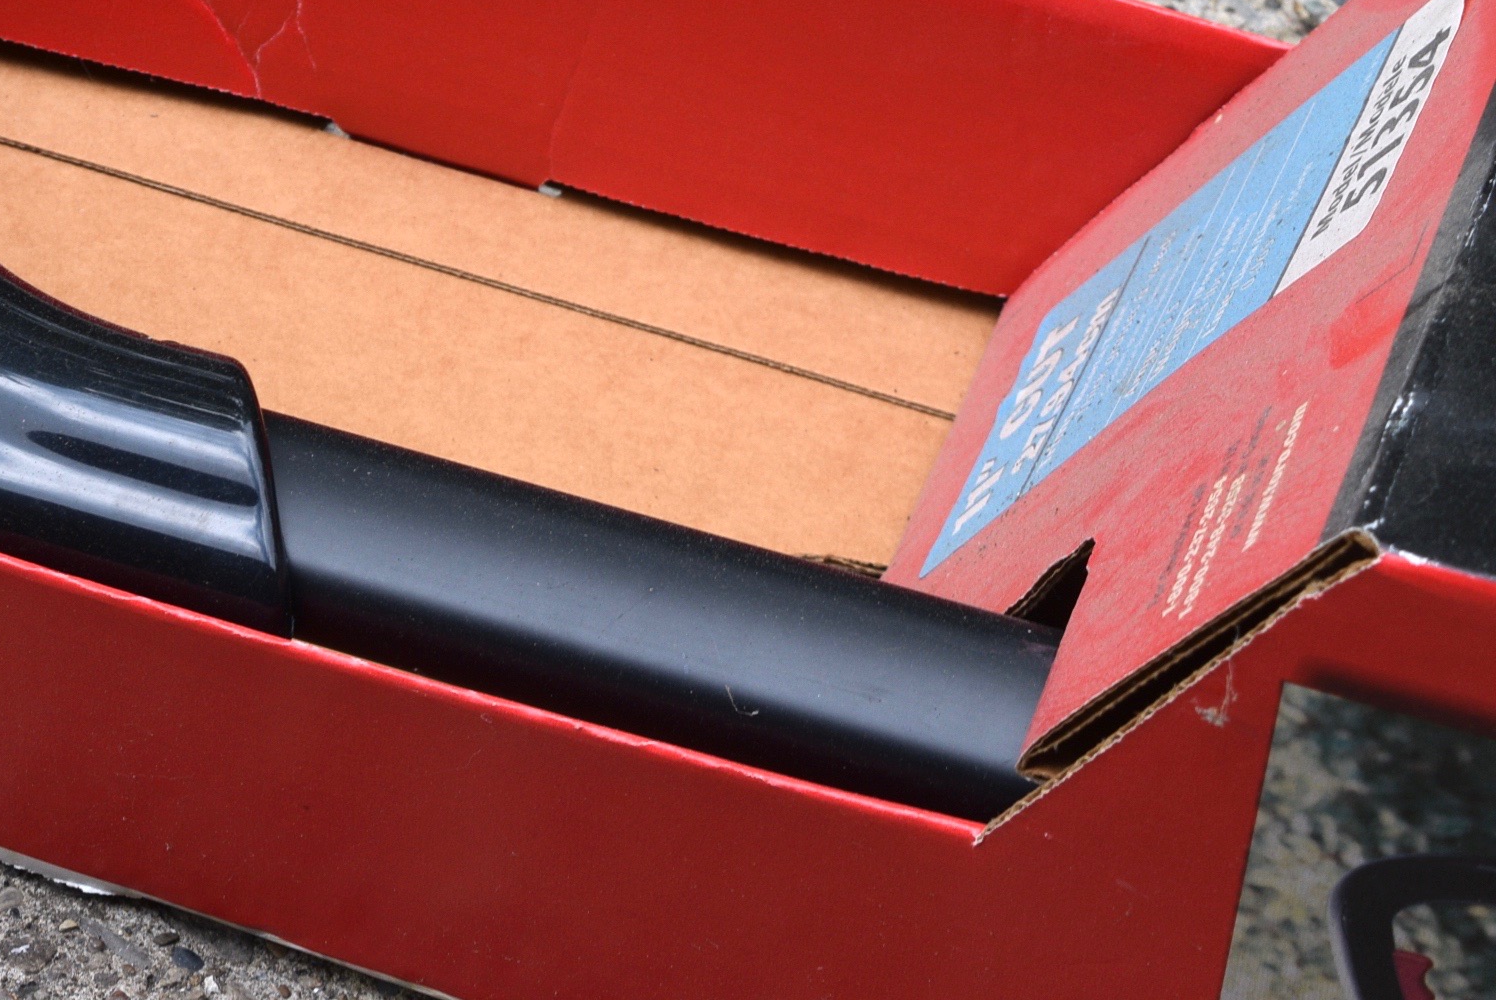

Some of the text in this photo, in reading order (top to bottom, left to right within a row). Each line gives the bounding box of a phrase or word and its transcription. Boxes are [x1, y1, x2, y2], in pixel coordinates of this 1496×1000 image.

[1312, 56, 1406, 240] Model/Modèle
[1340, 27, 1451, 212] 51354
[999, 315, 1081, 441] CUT
[1012, 286, 1122, 475] 27.94cm
[1162, 474, 1228, 619] 1-800-237-2654
[1178, 473, 1246, 621] 1-800-248-3258
[1242, 401, 1309, 553] www.toro.com
